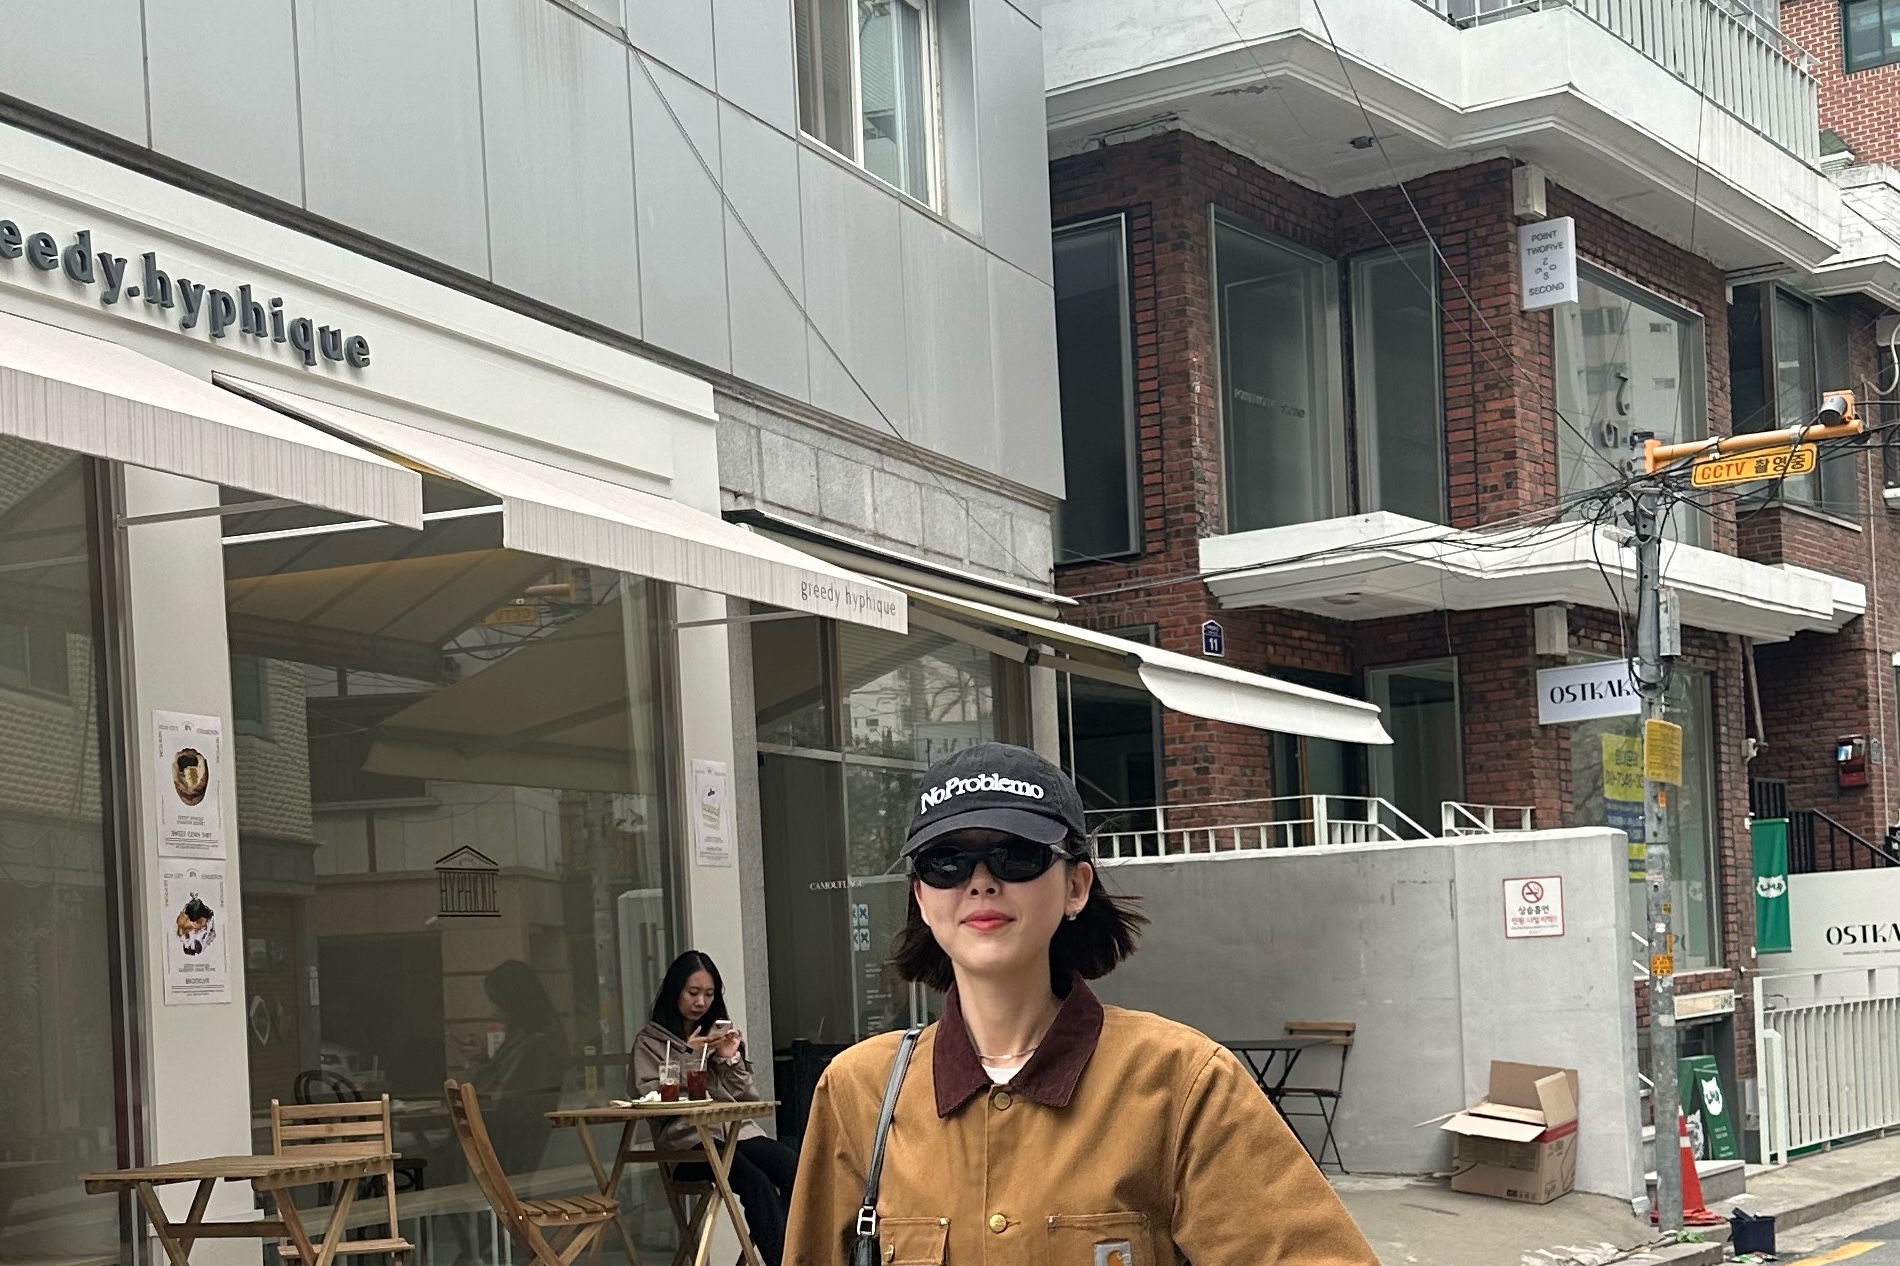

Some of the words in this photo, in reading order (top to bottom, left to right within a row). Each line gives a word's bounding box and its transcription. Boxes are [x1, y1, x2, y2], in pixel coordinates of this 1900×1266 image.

[1531, 230, 1557, 242] POINT
[1528, 282, 1565, 296] SECOND
[1701, 461, 1746, 480] CCTV
[1754, 453, 1806, 474] 촬영중
[801, 581, 840, 608] greedy
[845, 586, 896, 619] hyphique
[1209, 637, 1218, 651] 11
